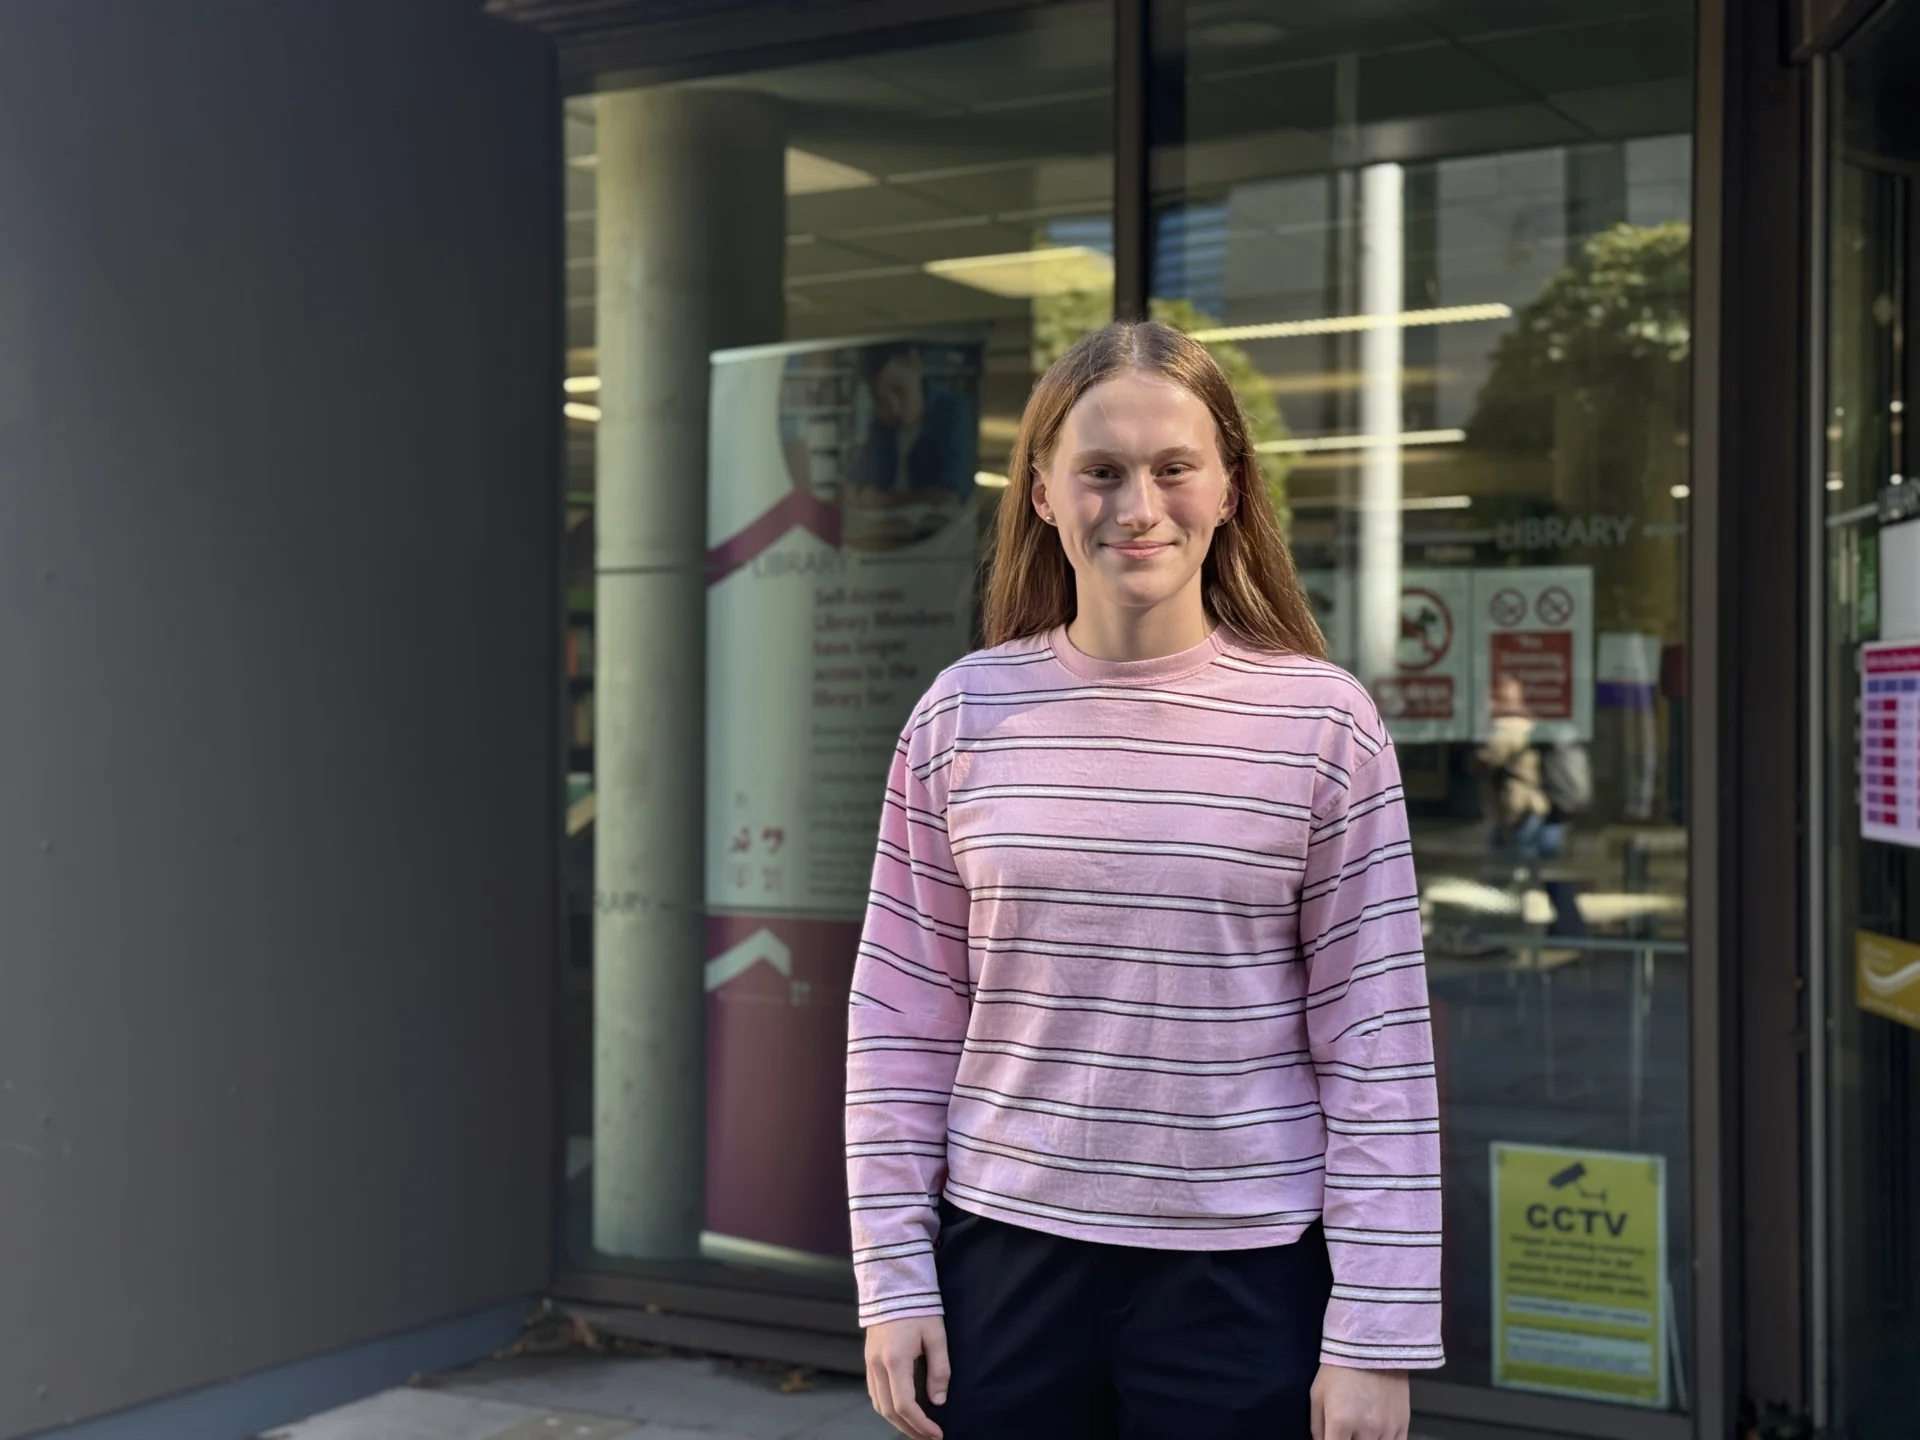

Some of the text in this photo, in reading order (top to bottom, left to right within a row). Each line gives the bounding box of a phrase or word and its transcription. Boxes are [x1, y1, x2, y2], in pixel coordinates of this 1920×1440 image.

[1496, 514, 1635, 550] LIBRARY
[752, 549, 848, 579] LIBRARY
[815, 609, 954, 632] Library Members
[1526, 1203, 1628, 1237] CCTV
